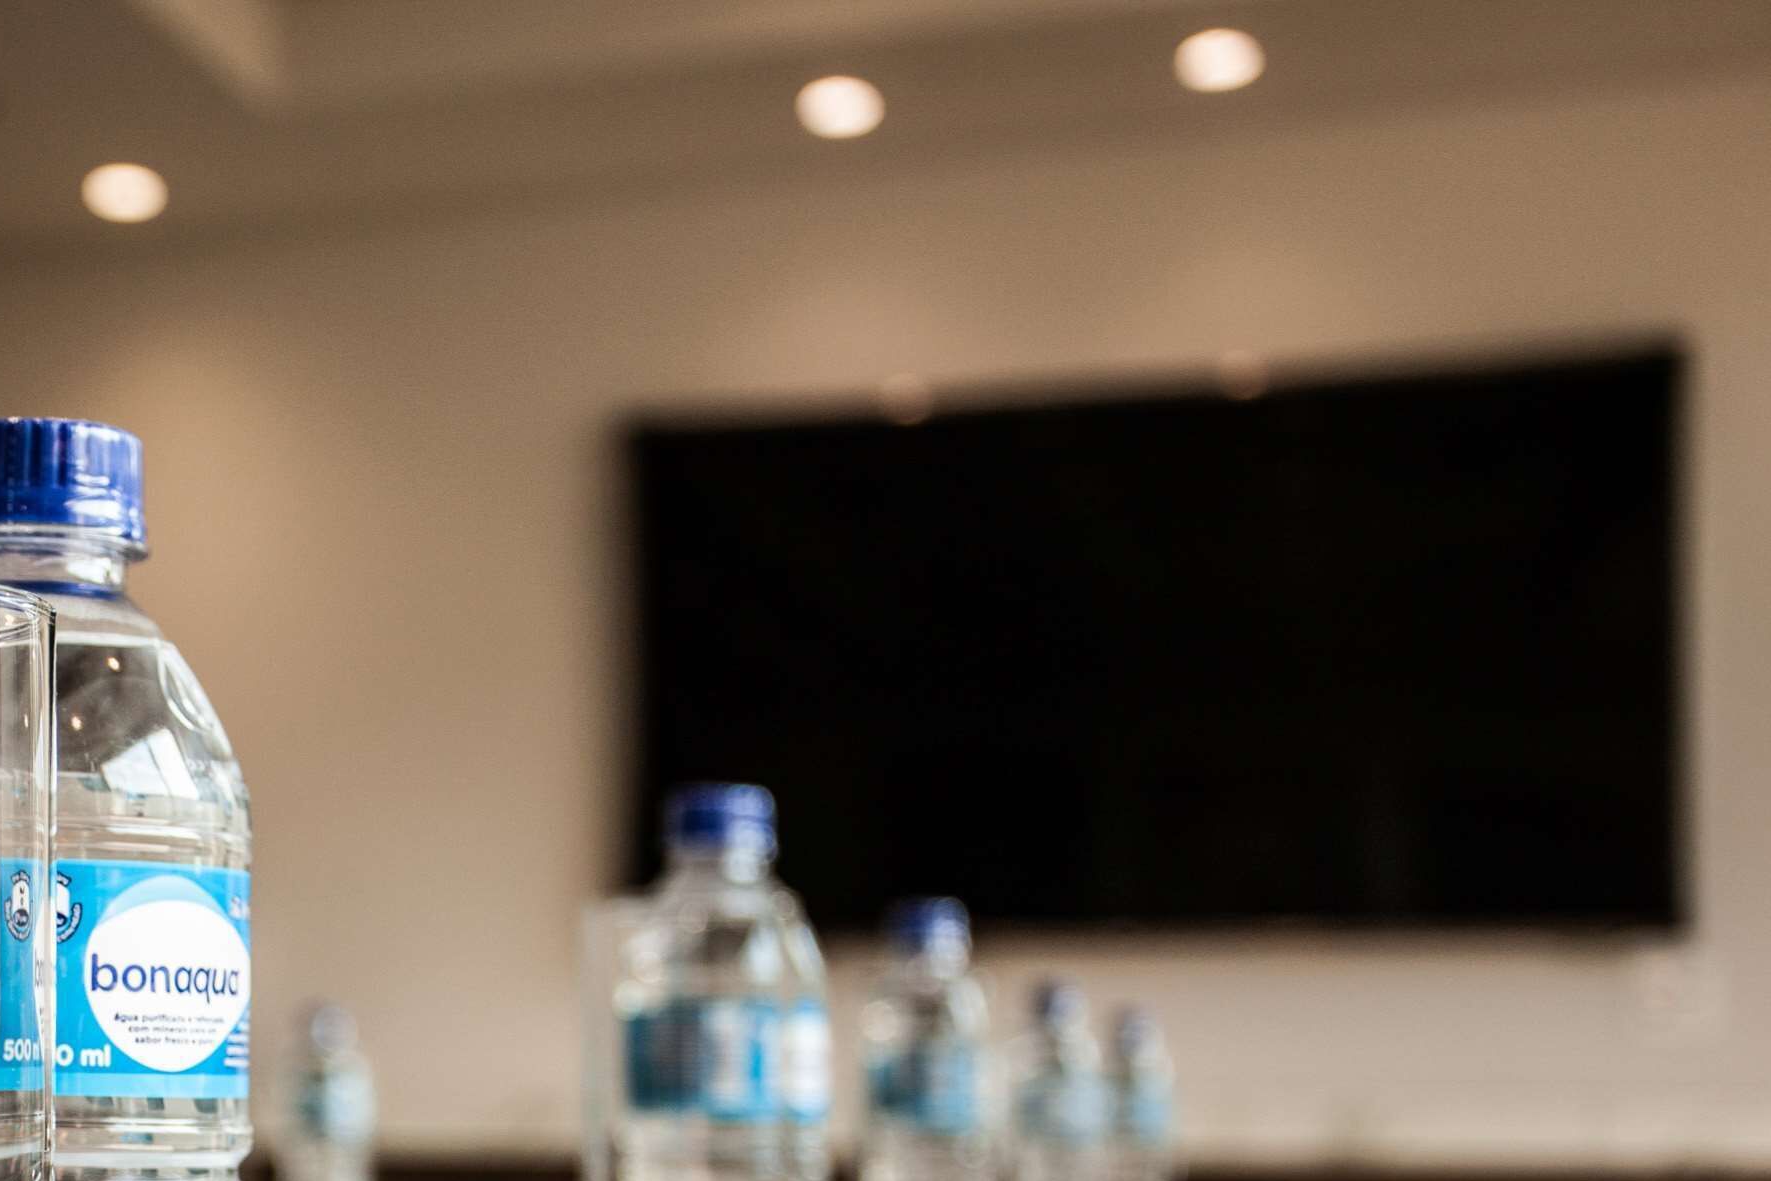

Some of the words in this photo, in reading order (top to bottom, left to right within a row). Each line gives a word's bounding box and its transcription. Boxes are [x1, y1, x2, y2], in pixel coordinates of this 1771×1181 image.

[91, 953, 239, 1004] bonaqua
[3, 1038, 32, 1062] 500
[80, 1043, 111, 1067] ml
